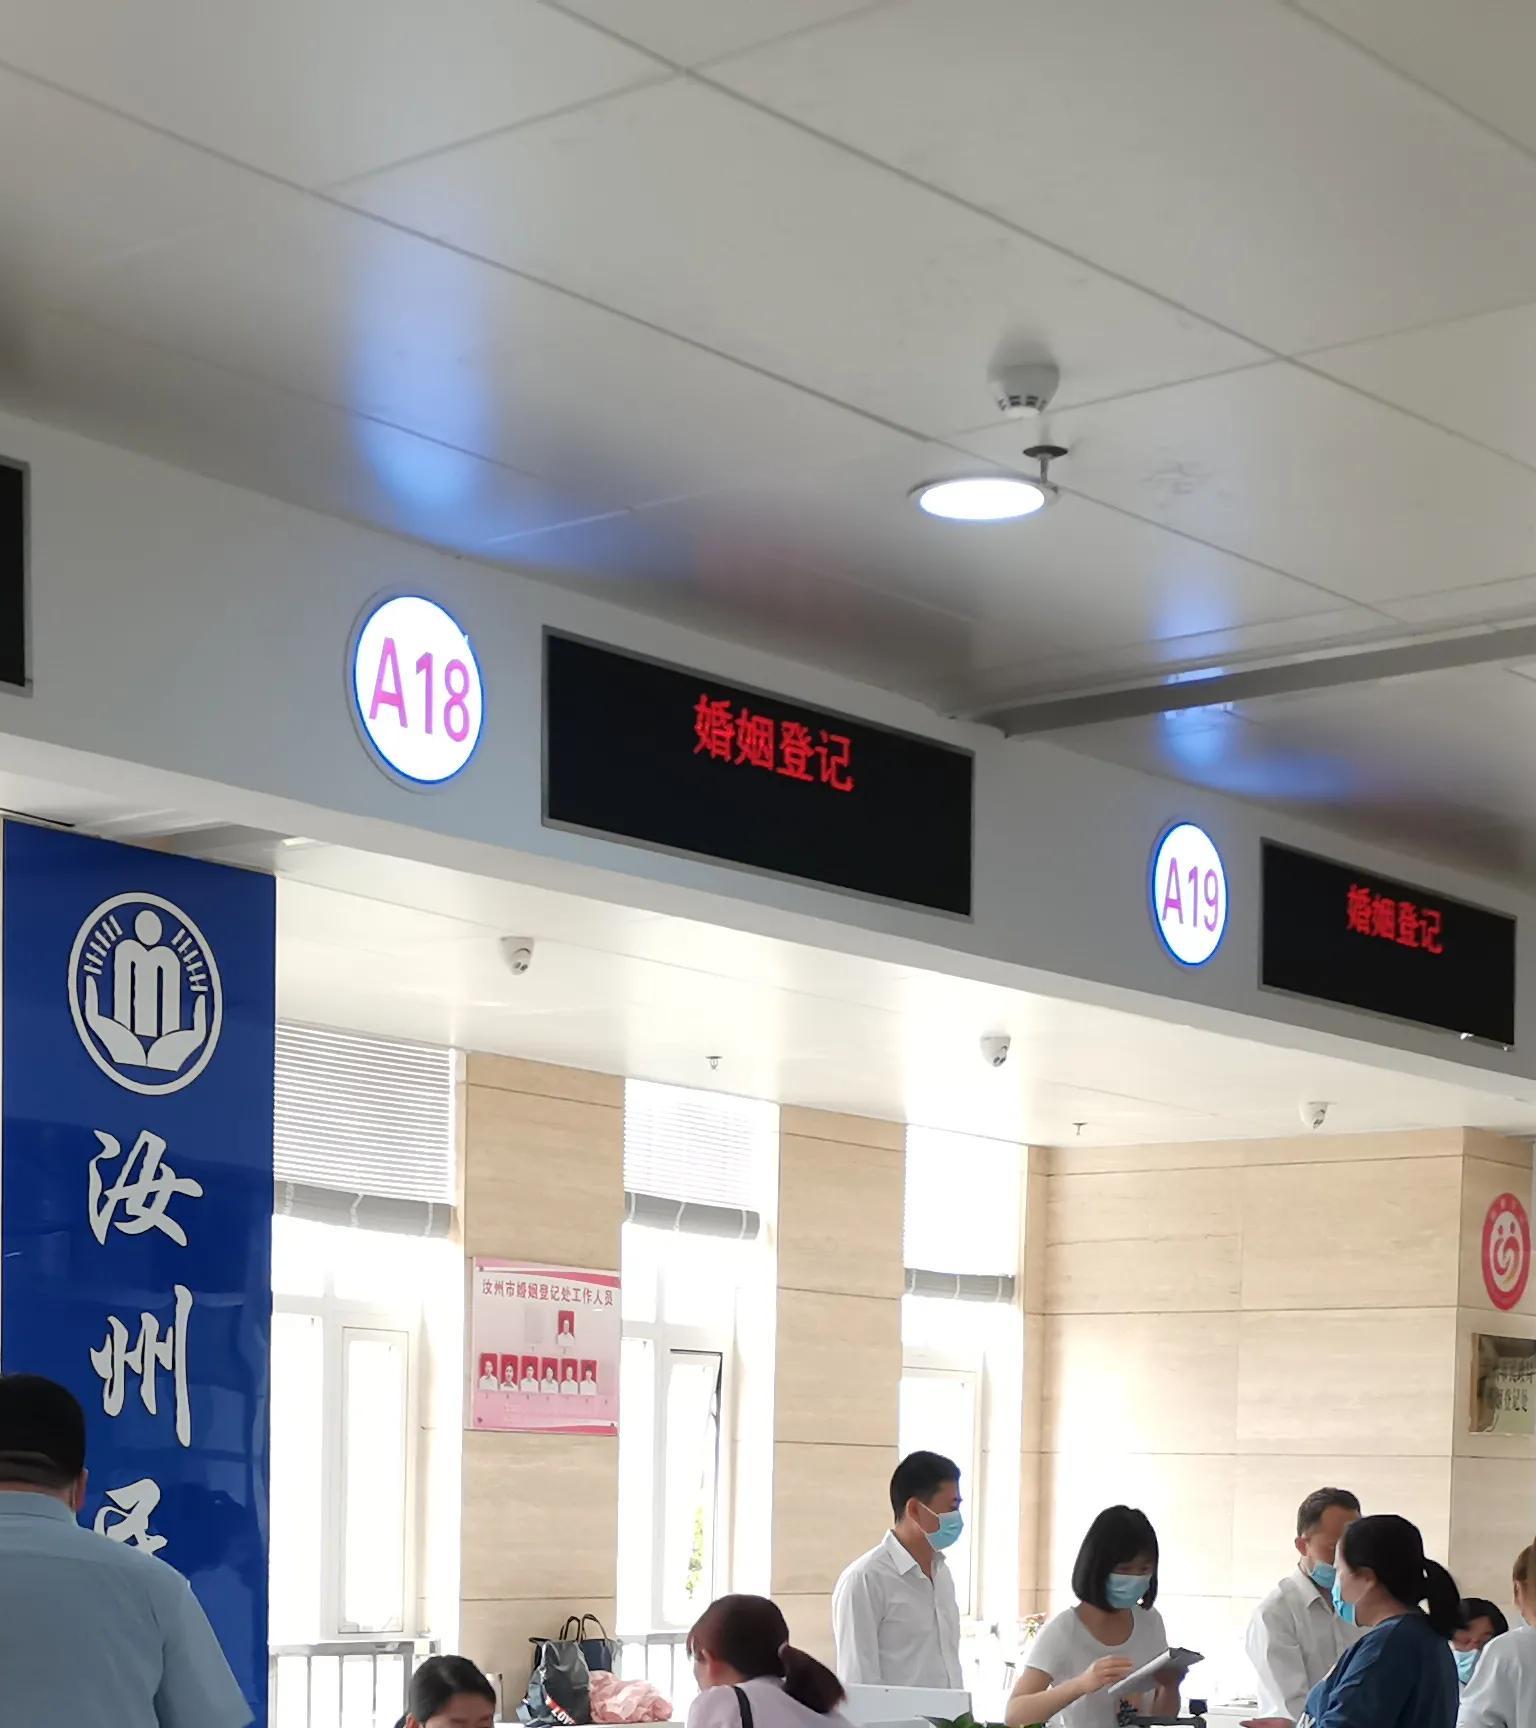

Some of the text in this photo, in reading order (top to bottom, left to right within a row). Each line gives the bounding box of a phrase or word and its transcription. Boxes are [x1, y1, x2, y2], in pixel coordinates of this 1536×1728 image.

[369, 637, 471, 743] A18
[694, 694, 855, 792] 婚姻登记
[1162, 857, 1219, 932] A19
[482, 1278, 614, 1306] 汝州市婚姻登记处工作人员
